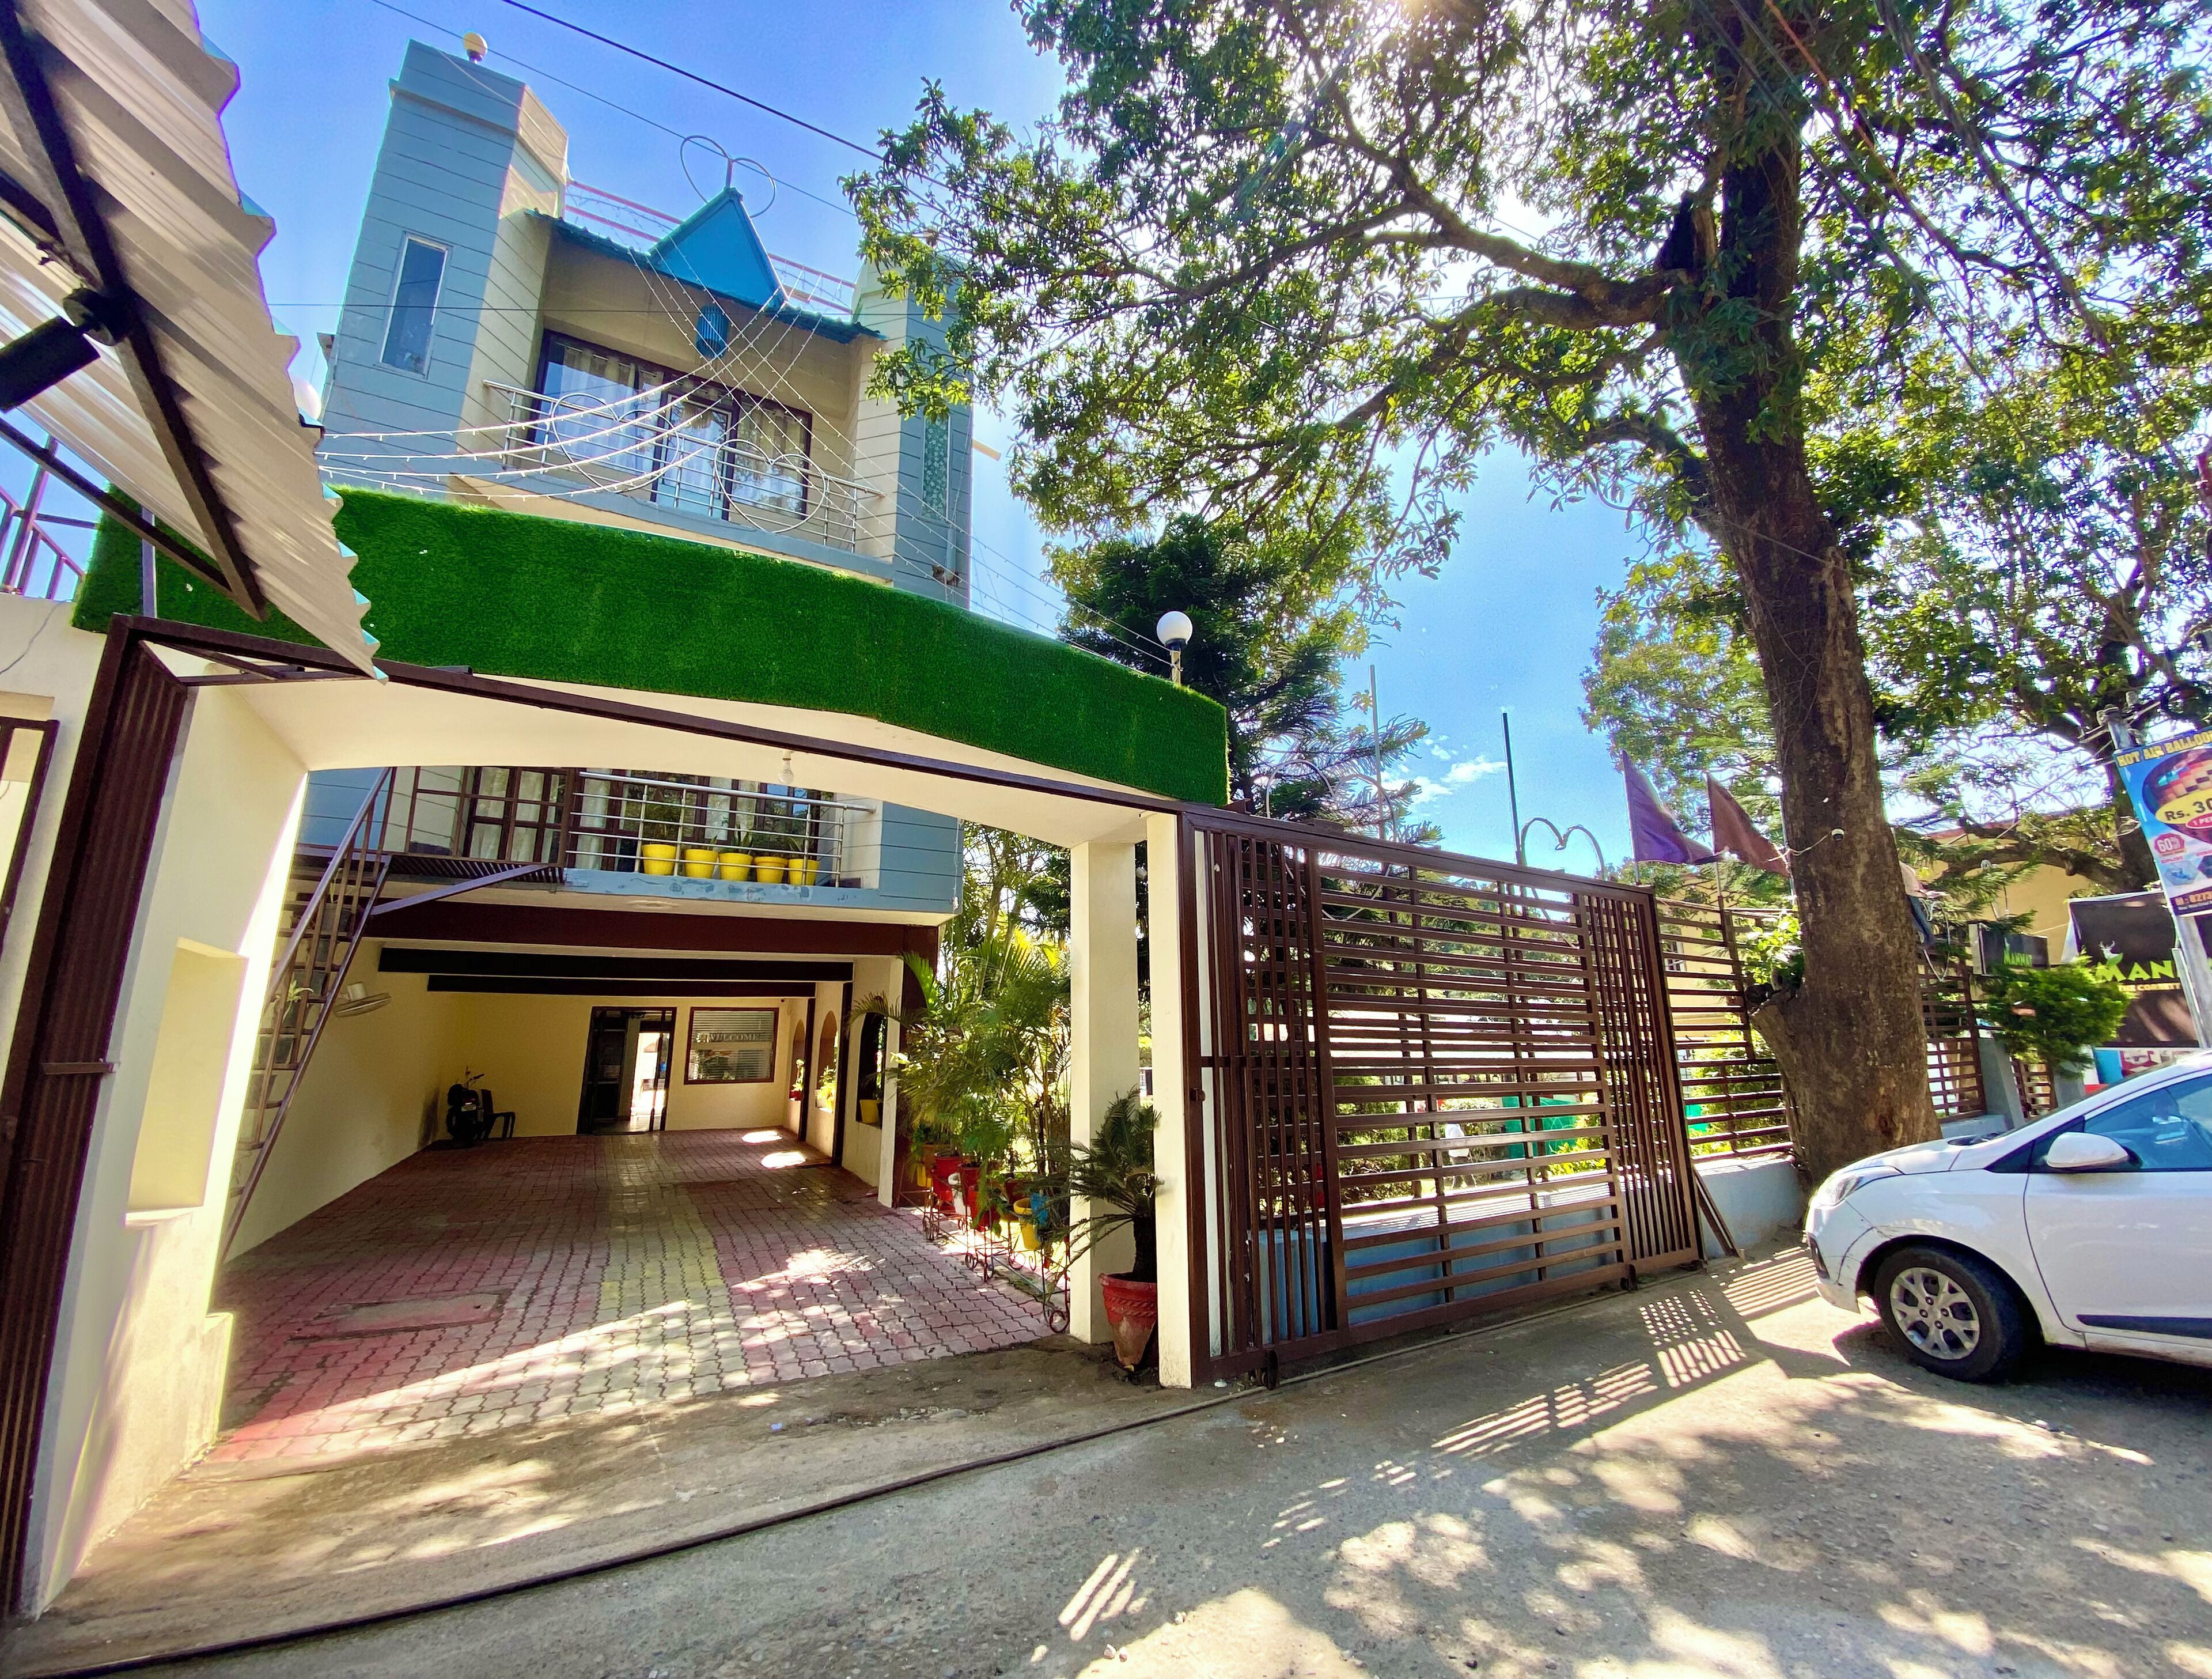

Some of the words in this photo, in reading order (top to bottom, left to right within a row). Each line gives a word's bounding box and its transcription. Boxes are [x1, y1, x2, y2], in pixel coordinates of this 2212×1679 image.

[2116, 751, 2141, 767] HOT
[2143, 746, 2165, 759] AIR
[2165, 810, 2190, 821] Rs.
[709, 1033, 760, 1042] WELCOME
